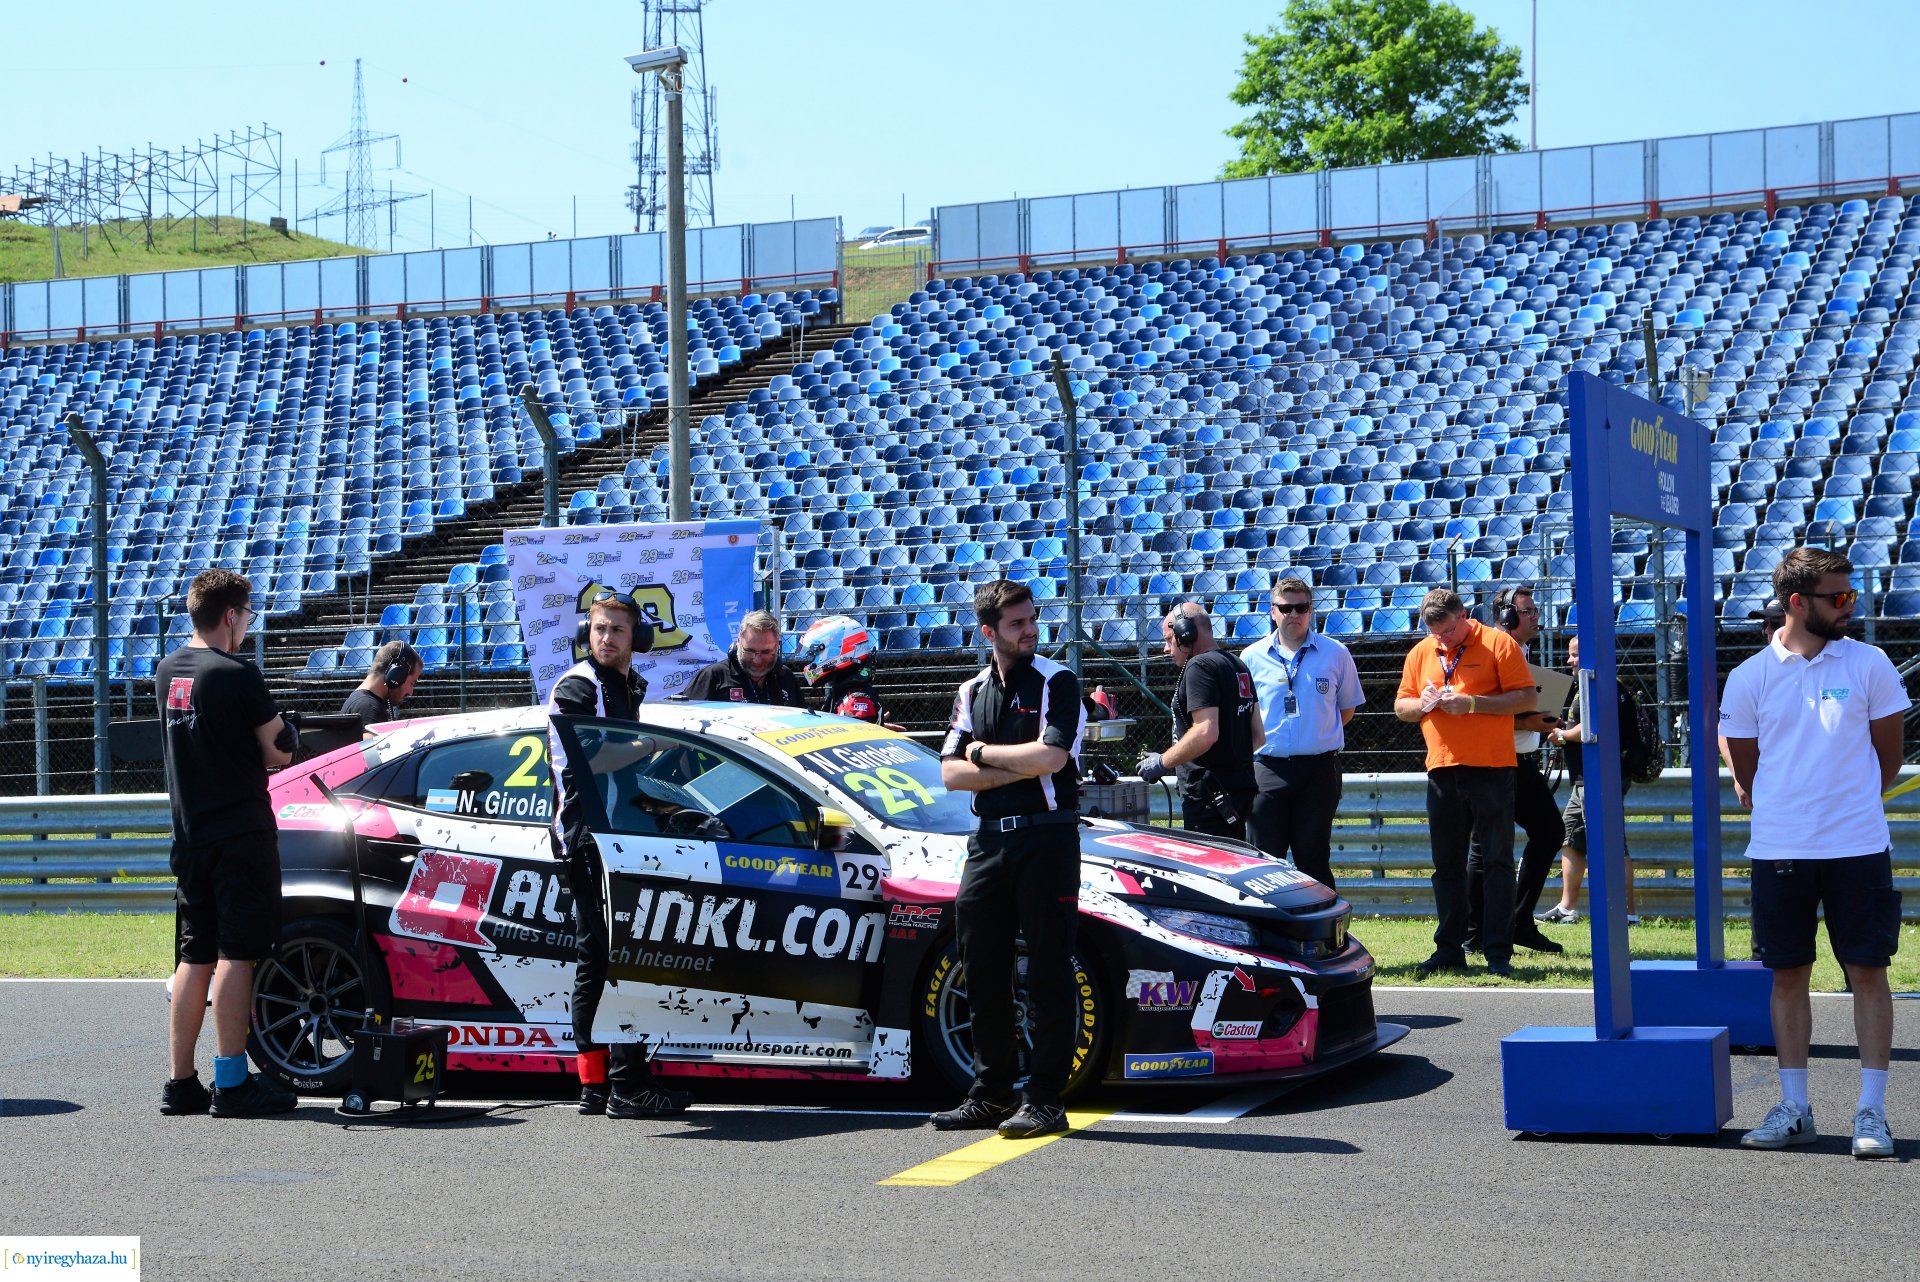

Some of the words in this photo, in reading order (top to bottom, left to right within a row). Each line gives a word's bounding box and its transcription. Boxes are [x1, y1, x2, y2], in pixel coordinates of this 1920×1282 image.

[1630, 416, 1679, 465] GOODYEAR
[587, 551, 605, 567] 29
[640, 549, 658, 564] 29
[691, 547, 702, 561] 2
[518, 575, 536, 591] 29
[620, 573, 638, 588] 29
[671, 570, 689, 584] 29
[542, 594, 565, 610] 29
[692, 591, 703, 605] 2
[529, 619, 543, 637] 29
[678, 614, 693, 627] 29
[552, 636, 569, 654] 29
[539, 664, 556, 681] 29
[663, 671, 684, 690] 29
[775, 727, 848, 746] GOODYEAR
[503, 736, 552, 788] 2
[831, 742, 922, 770] Girolami
[843, 767, 936, 816] 29
[458, 789, 478, 814] N.
[485, 790, 552, 817] Girola
[725, 855, 833, 878] GOODYEAR
[842, 861, 880, 891] 29
[889, 904, 942, 925] HRC
[492, 921, 540, 943] Alles
[634, 947, 715, 972] Internet
[925, 955, 951, 1018] EAGLE
[1138, 981, 1199, 1006] KW
[1223, 1023, 1259, 1036] Castrol
[1130, 1057, 1209, 1072] GOODYEAR
